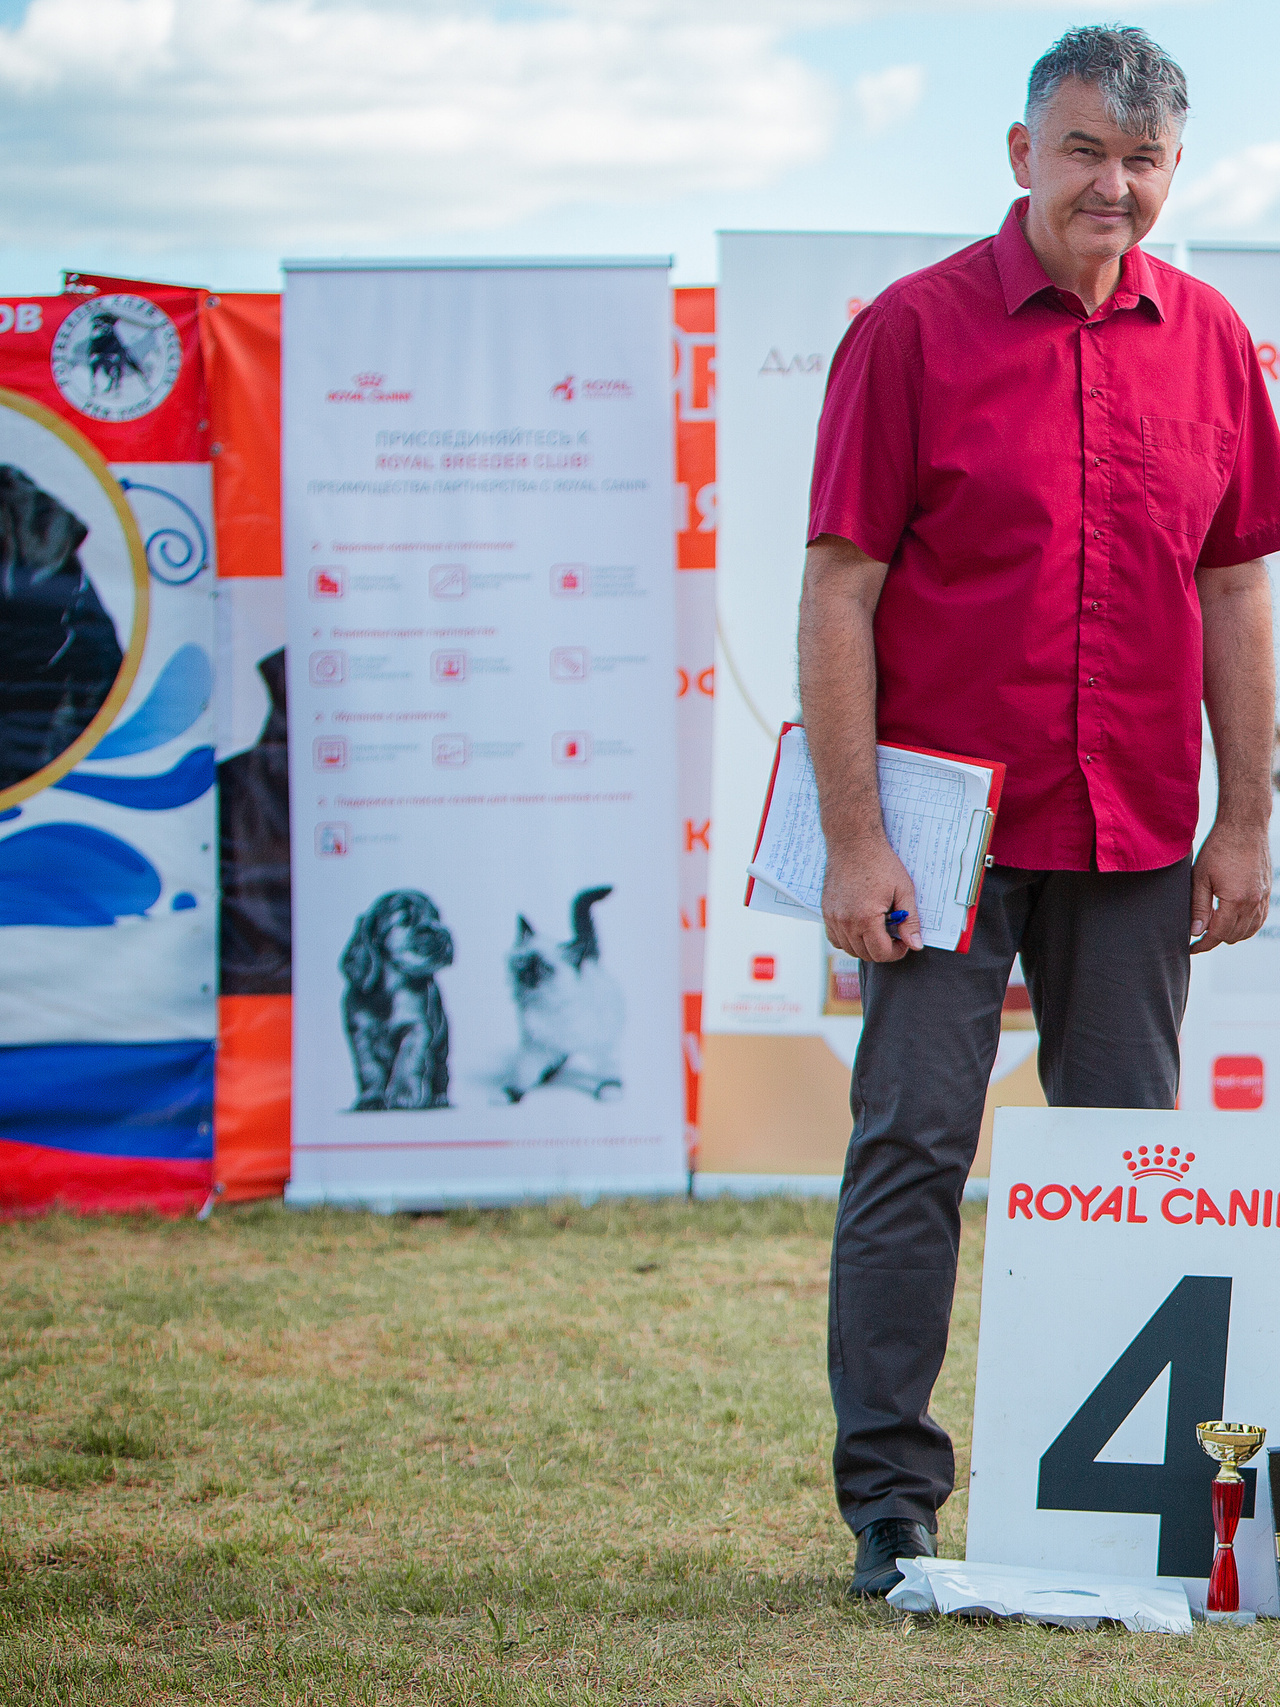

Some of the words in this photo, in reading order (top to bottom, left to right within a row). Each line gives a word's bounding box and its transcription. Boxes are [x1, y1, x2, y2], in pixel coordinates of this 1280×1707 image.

[759, 350, 823, 375] Для
[375, 453, 434, 471] ROYAL
[1008, 1183, 1148, 1223] ROYAL
[1036, 1275, 1258, 1578] 4
